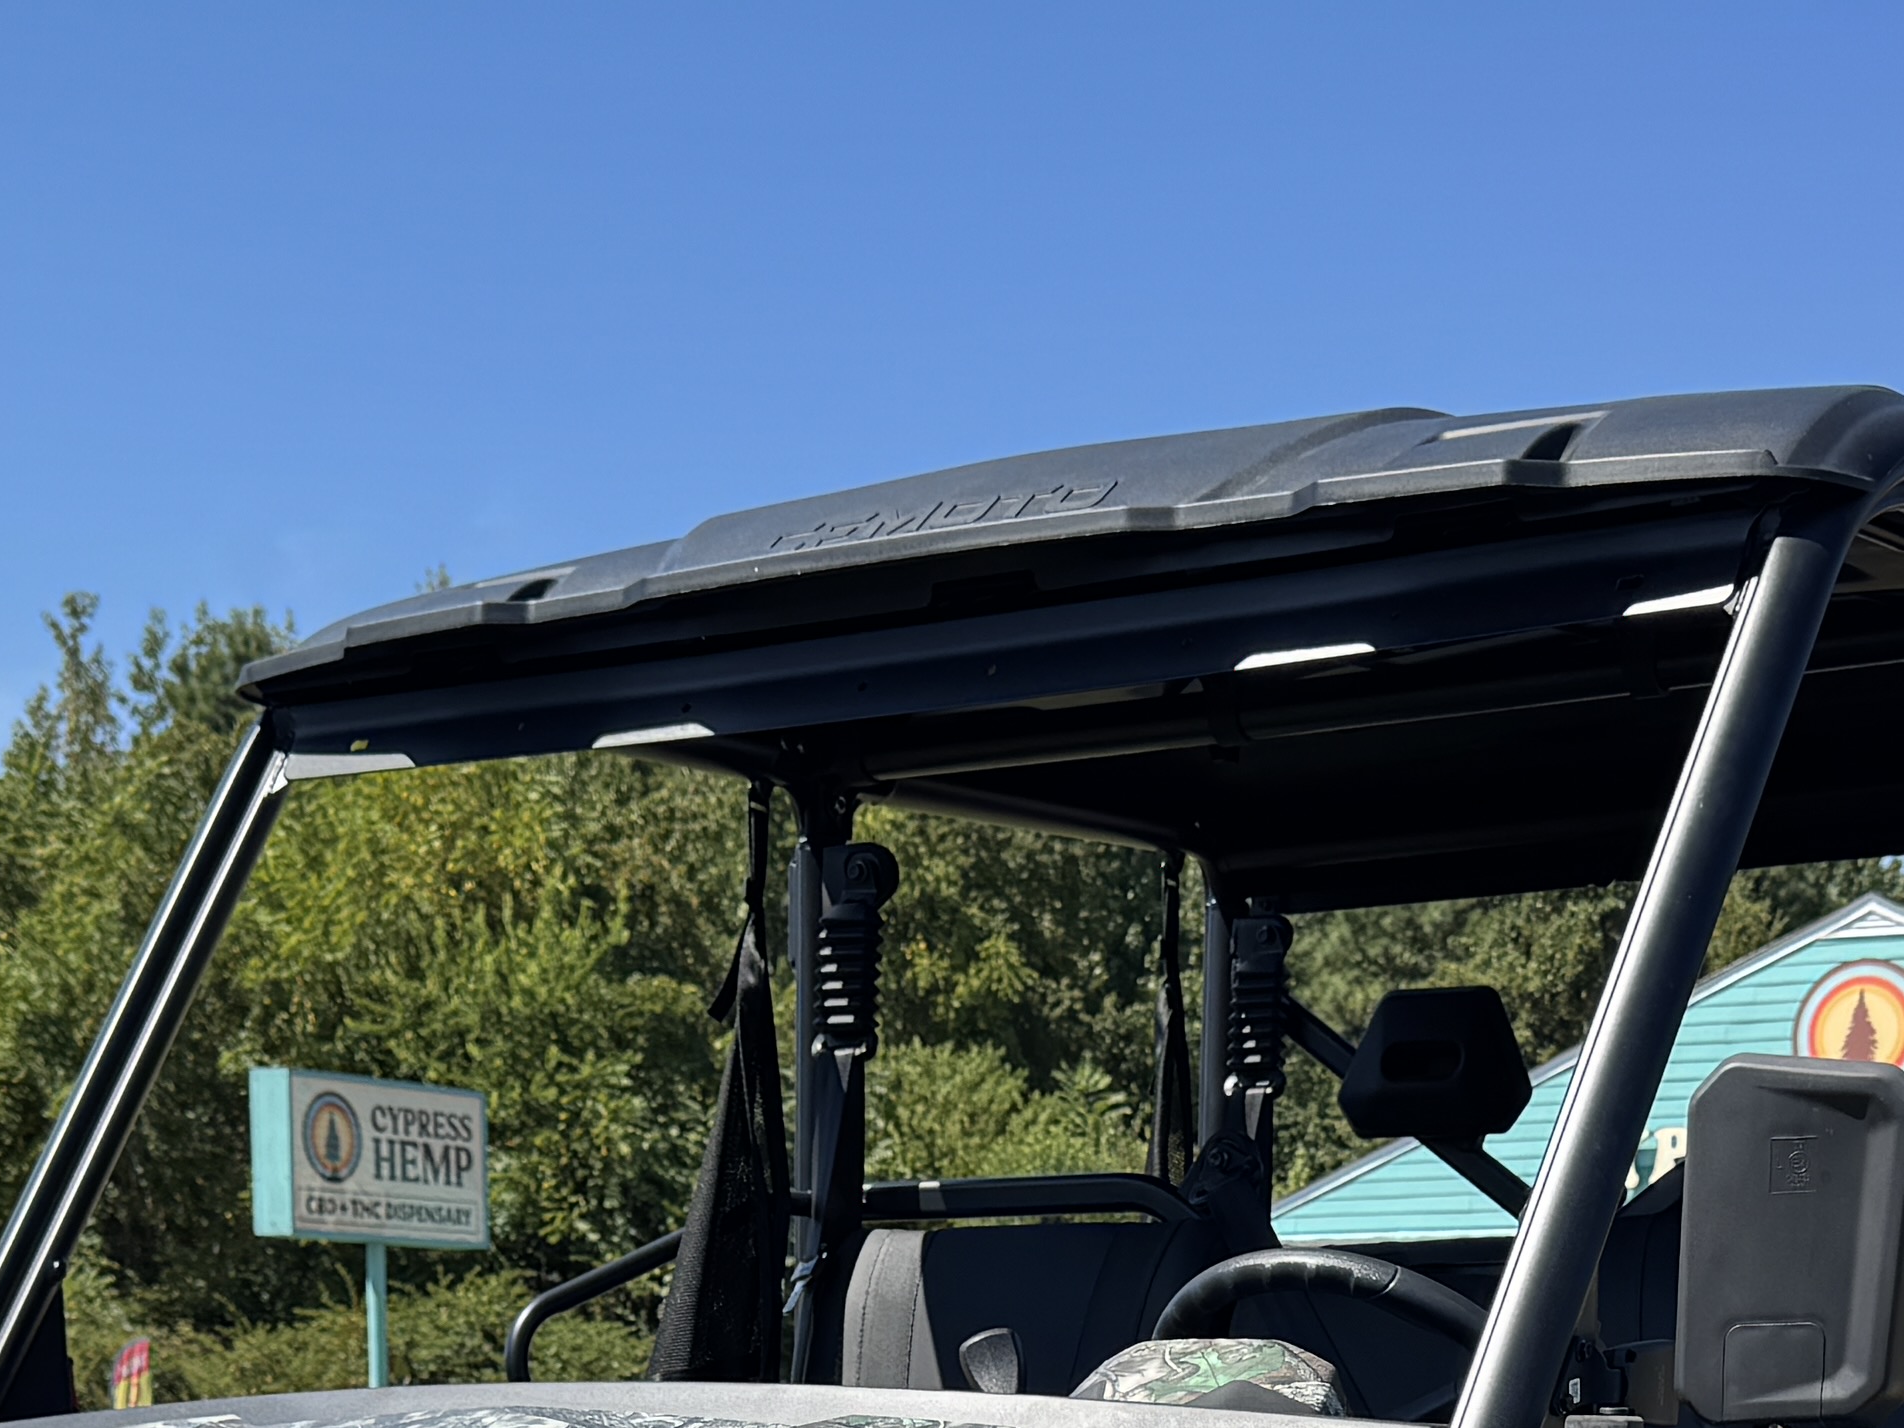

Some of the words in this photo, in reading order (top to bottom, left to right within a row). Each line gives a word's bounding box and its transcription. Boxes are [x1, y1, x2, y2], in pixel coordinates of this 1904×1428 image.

[371, 1105, 473, 1142] CYPRESS
[372, 1137, 472, 1187] HEMP
[384, 1202, 473, 1227] DISPENSARY
